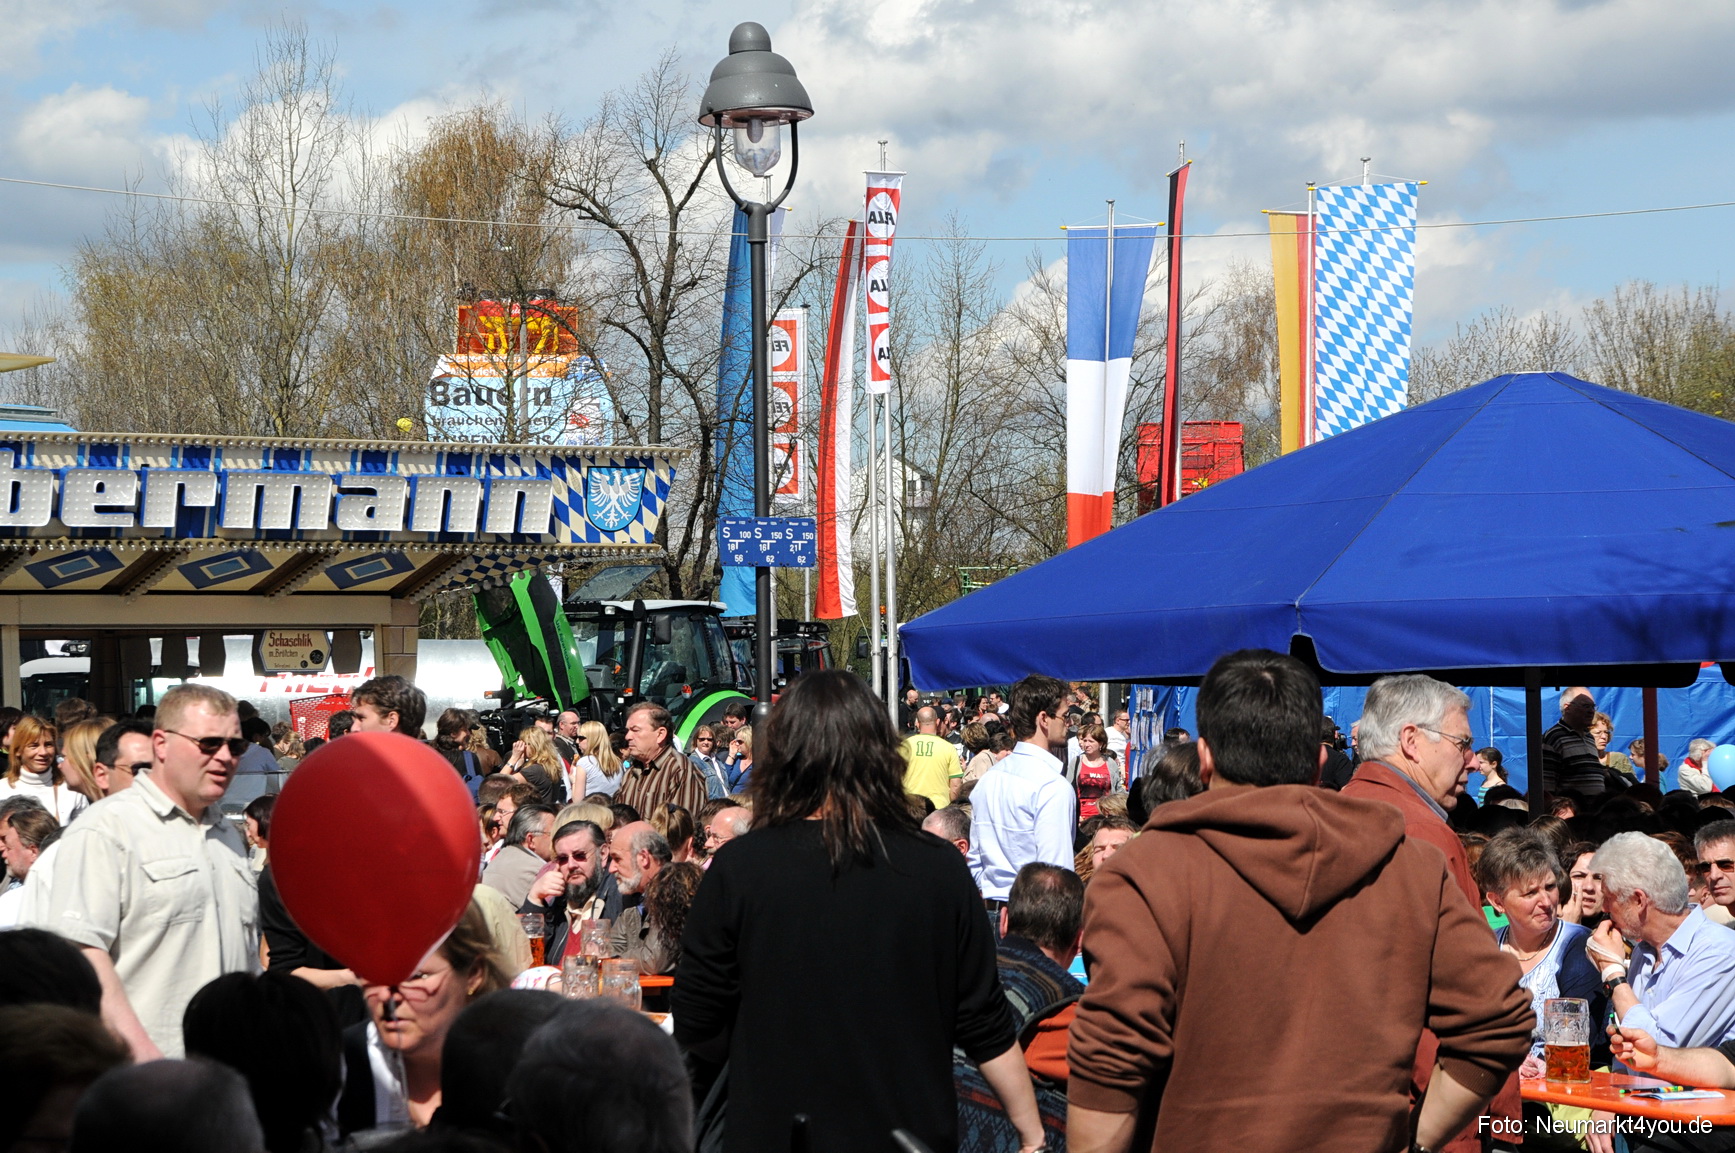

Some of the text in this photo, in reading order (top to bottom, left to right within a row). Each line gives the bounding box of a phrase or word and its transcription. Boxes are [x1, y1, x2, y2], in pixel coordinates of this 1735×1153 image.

[722, 527, 752, 539] S 100
[754, 527, 762, 539] S
[785, 528, 793, 539] S
[268, 632, 313, 647] Schaschlik
[916, 741, 934, 757] 11
